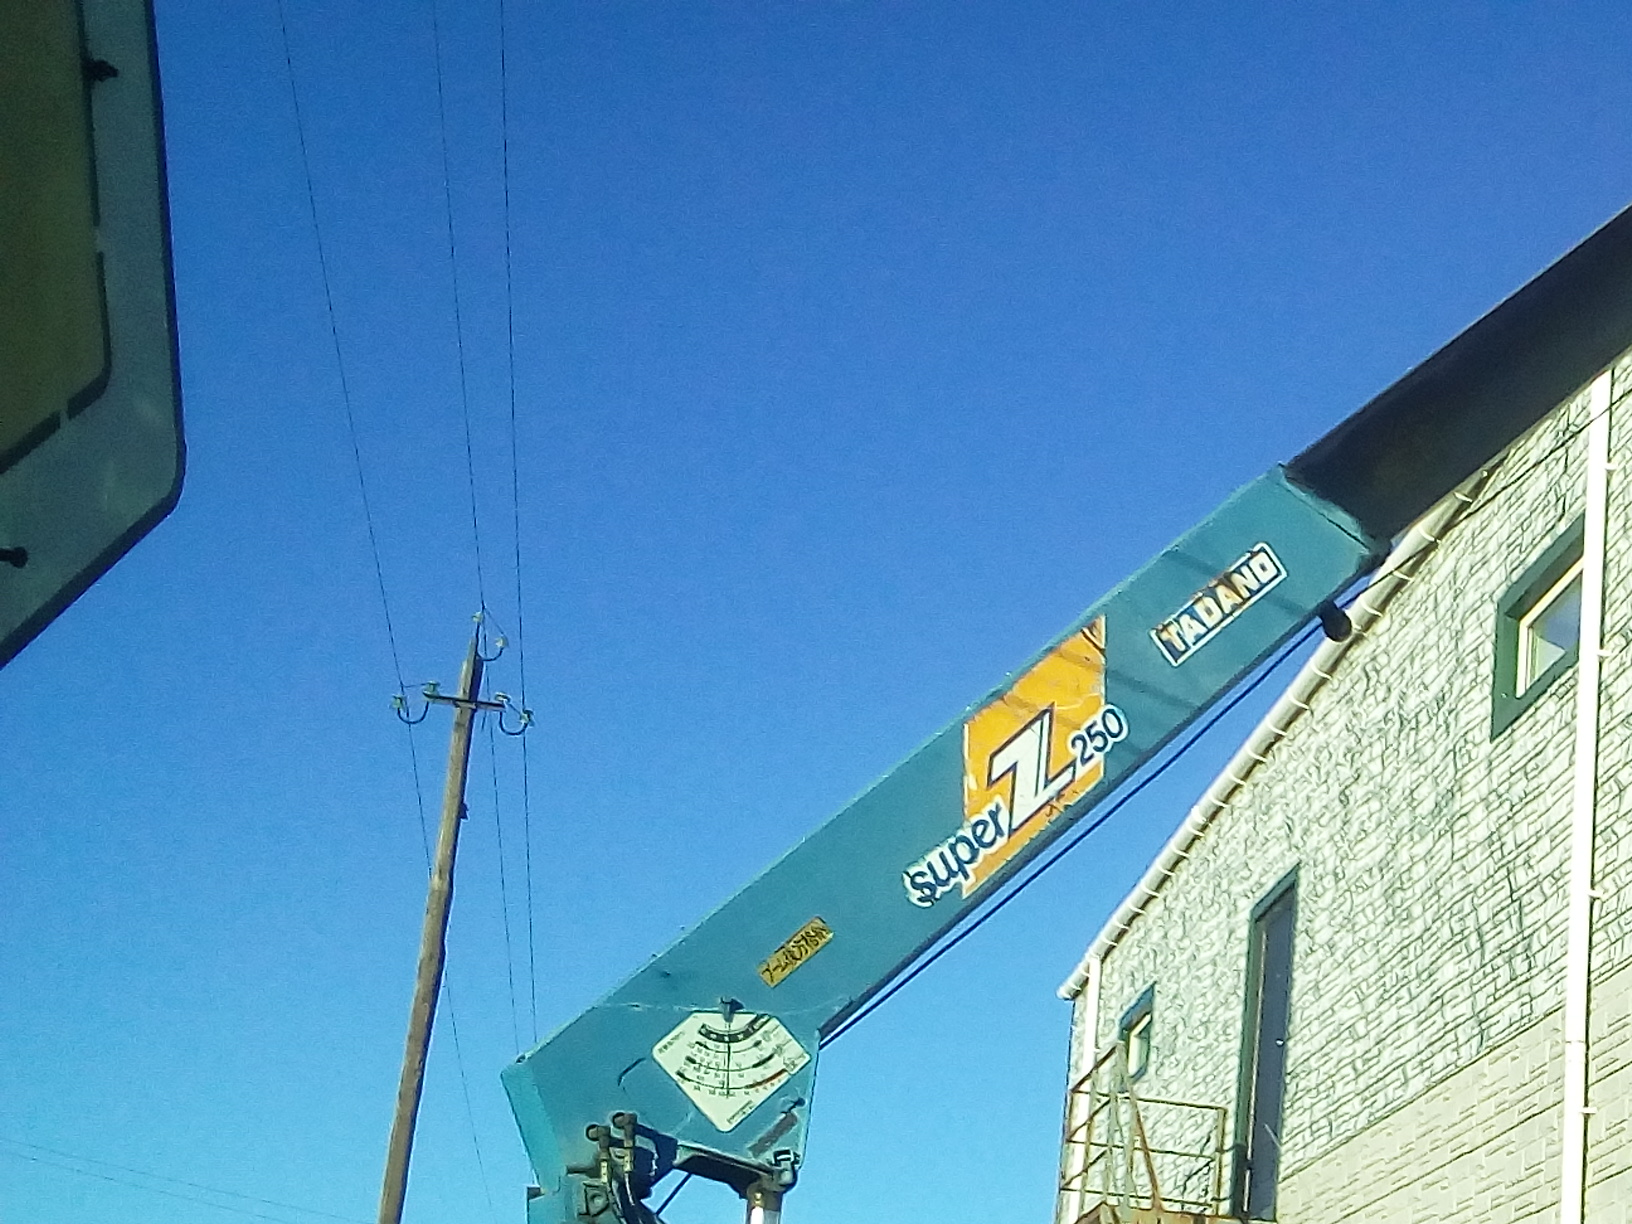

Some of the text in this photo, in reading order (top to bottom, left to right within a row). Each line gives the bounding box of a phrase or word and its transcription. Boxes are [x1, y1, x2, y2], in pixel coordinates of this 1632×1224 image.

[1160, 550, 1282, 655] TADANO
[905, 702, 1126, 905] super Z 250
